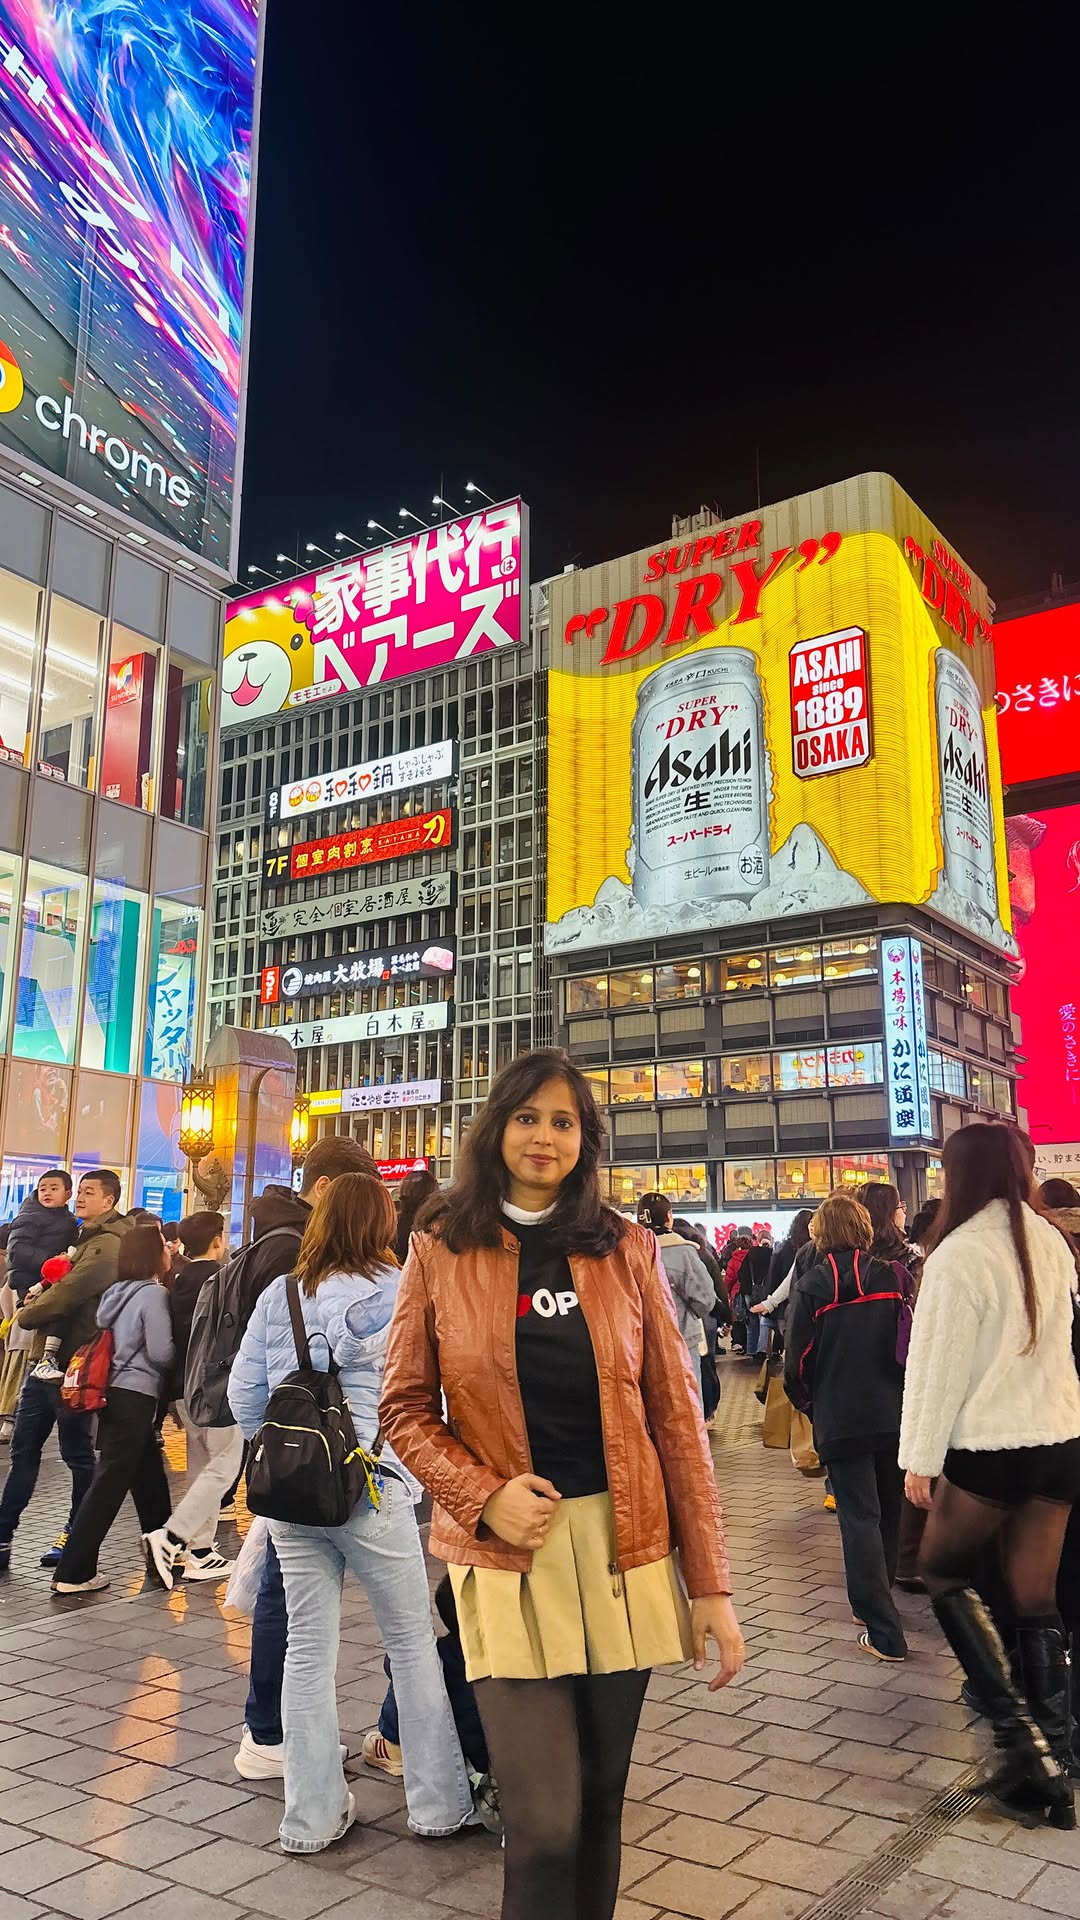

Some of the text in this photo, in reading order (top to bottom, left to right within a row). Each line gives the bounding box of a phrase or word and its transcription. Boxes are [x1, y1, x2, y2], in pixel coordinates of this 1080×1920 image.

[35, 394, 193, 508] chrome
[643, 519, 761, 583] SUPER
[933, 539, 972, 595] SUPER
[312, 578, 520, 692] ベアーズ
[664, 677, 683, 690] KARA
[707, 667, 729, 676] KUCHI
[793, 637, 863, 687] ASAHI
[677, 694, 717, 713] SUPER
[811, 677, 844, 695] since
[794, 687, 863, 732] 1889
[643, 727, 752, 800] Asahi
[797, 729, 865, 770] OSAKA
[943, 730, 986, 804] Asahi
[683, 790, 712, 813] 生
[295, 837, 374, 869] 個室肉割烹
[421, 814, 446, 845] 刀
[666, 823, 732, 848] スーパードライ
[265, 854, 289, 878] 7F
[740, 856, 763, 875] お酒
[303, 970, 332, 986] 焼肉屋
[889, 968, 909, 1031] 本場の味
[366, 1010, 427, 1037] 白木屋
